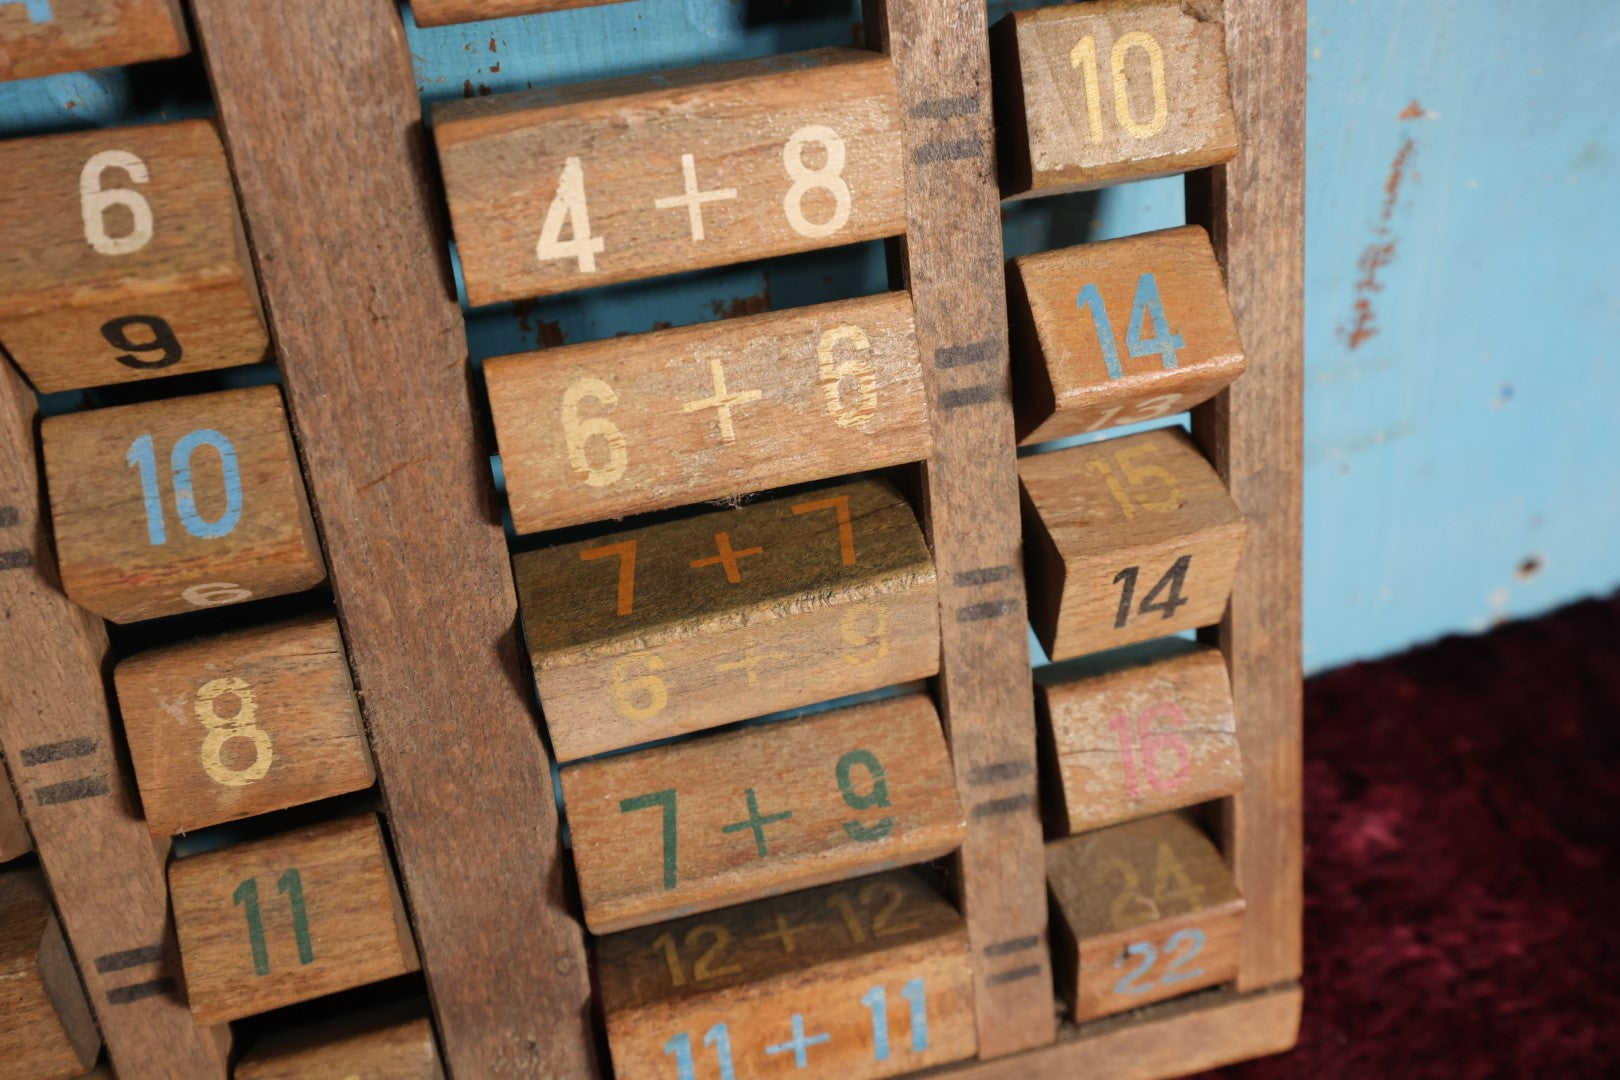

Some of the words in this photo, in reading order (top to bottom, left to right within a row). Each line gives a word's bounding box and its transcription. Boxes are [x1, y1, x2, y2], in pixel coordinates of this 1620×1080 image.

[1070, 31, 1169, 145] 10
[80, 150, 154, 256] 6
[536, 156, 605, 273] 4
[783, 124, 851, 238] 8
[100, 315, 183, 370] 9
[1077, 273, 1184, 379] 14
[562, 378, 628, 488] 6
[817, 324, 878, 430] 6
[1083, 393, 1183, 432] 13
[126, 428, 243, 545] 10
[1085, 443, 1187, 520] 15
[182, 582, 252, 606] 6
[579, 539, 637, 616] 7
[791, 495, 856, 566] 7
[1112, 555, 1192, 630] 14
[609, 651, 669, 720] 6
[838, 604, 890, 665] 9
[194, 677, 273, 786] 8
[1107, 701, 1191, 799] 16
[619, 788, 677, 890] 7
[835, 749, 895, 843] 9
[233, 867, 313, 976] 11
[653, 923, 742, 987] 12
[826, 881, 920, 943] 12
[1103, 841, 1204, 929] 24
[1113, 928, 1206, 995] 22
[664, 1022, 736, 1080] 11
[860, 976, 929, 1061] 11
